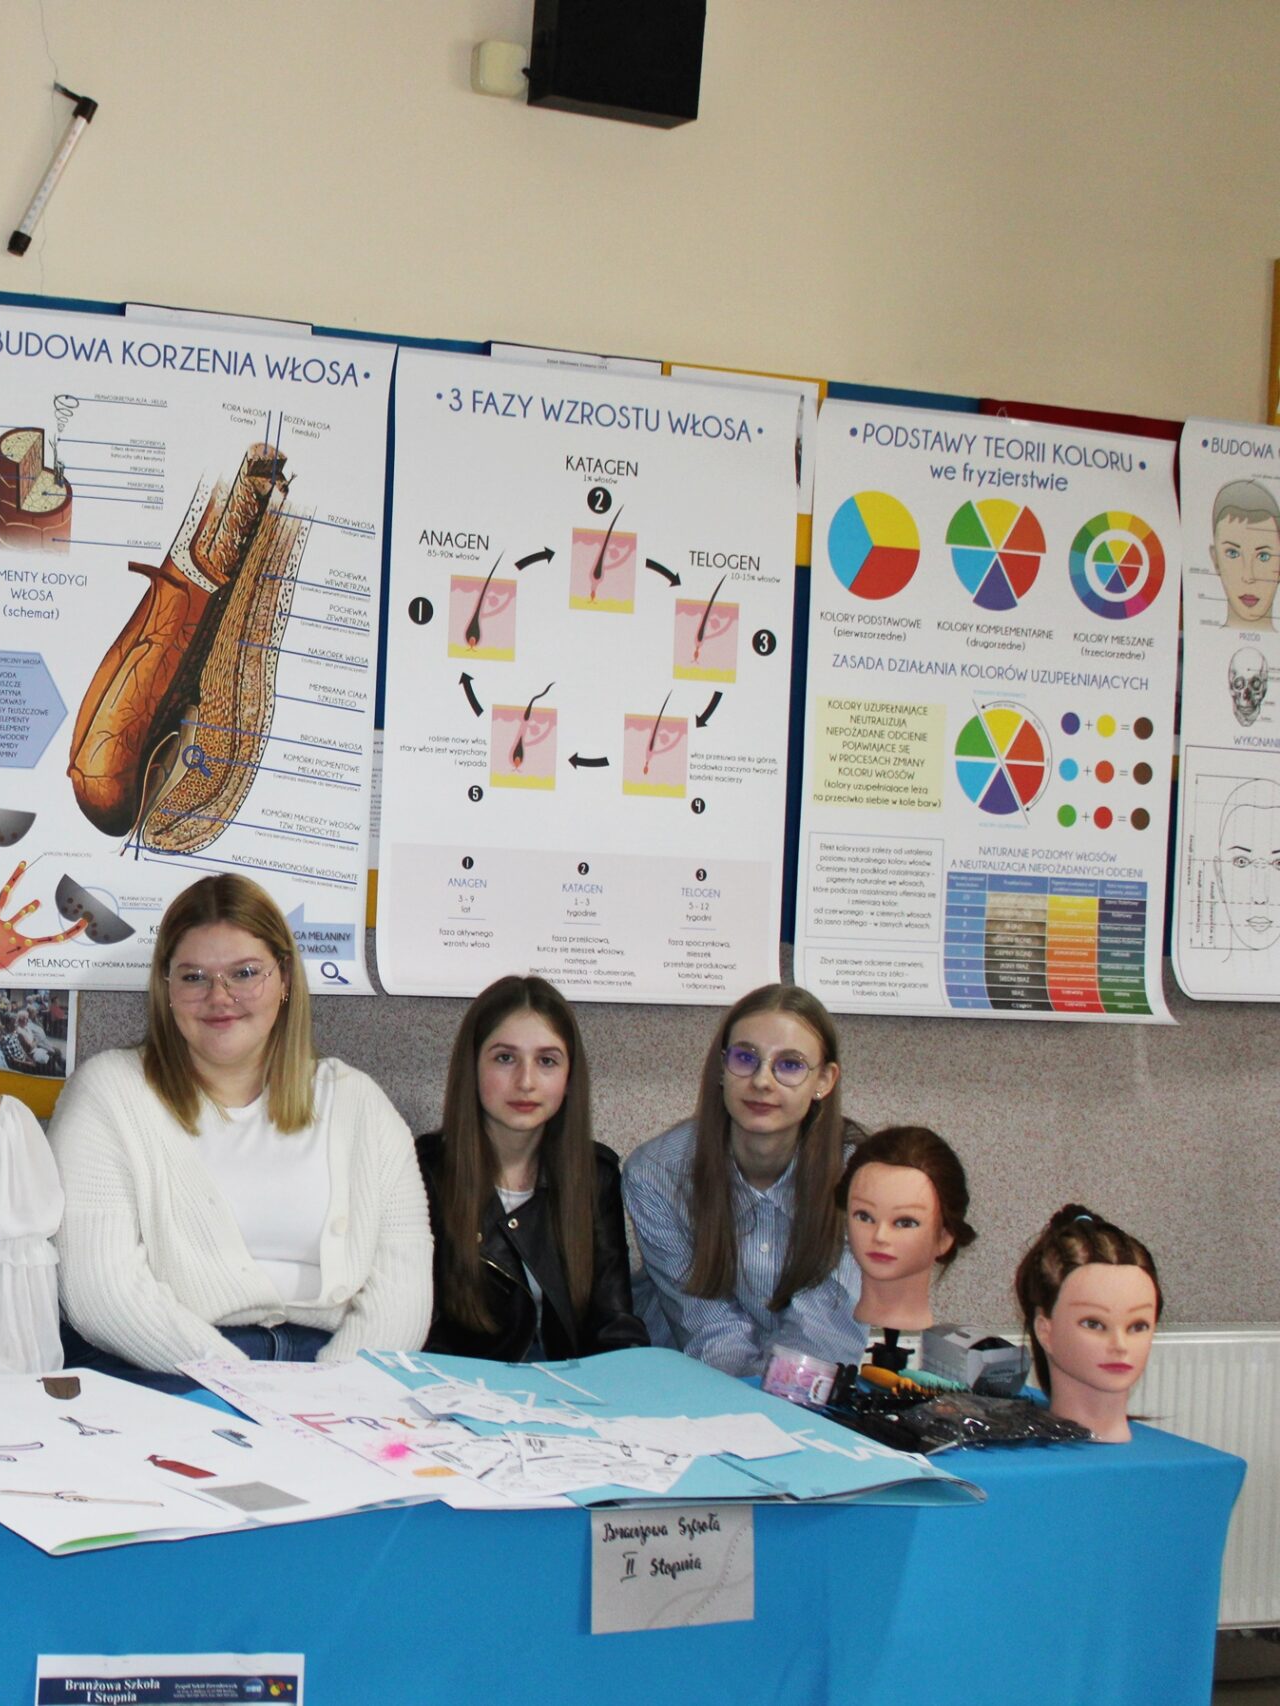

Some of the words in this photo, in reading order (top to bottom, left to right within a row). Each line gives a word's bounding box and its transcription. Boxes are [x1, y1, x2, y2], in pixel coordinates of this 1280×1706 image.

[122, 340, 257, 378] KORZENIA
[265, 354, 358, 387] WŁOSA
[448, 388, 463, 412] 3
[472, 390, 533, 419] FAZY
[541, 397, 660, 432] WZROSTU
[668, 410, 752, 443] WŁOSA
[862, 422, 977, 455] PODSTAWY
[983, 435, 1045, 463] TEORII
[1052, 444, 1133, 473] KOLORU
[1211, 437, 1274, 459] BUDOWA
[566, 455, 638, 477] KATAGEN
[930, 463, 956, 481] we
[962, 462, 1069, 492] fryzjerstwie
[595, 490, 603, 511] 2
[418, 529, 489, 551] ANAGEN
[689, 550, 760, 571] TELOGEN
[41, 573, 88, 588] ŁODYGI
[11, 588, 54, 602] WŁOSA
[2, 604, 60, 620] (schemat)
[820, 611, 856, 625] KOLORY
[857, 615, 922, 629] PODSTAWOWE
[937, 621, 973, 633] KOLORY
[975, 623, 1054, 640] KOMPLEMENTARNE
[759, 633, 769, 653] 3
[1073, 632, 1108, 645] KOLORY
[1110, 634, 1155, 648] MIESZANE
[832, 653, 885, 671] ZASADA
[888, 658, 958, 676] DZIAŁANIA
[960, 663, 1029, 682] KOLORÓW
[828, 700, 862, 711] KOLORY
[887, 730, 928, 742] ODCIENIE
[839, 754, 891, 766] PROCESACH
[892, 757, 925, 768] ZMIANY
[838, 767, 873, 778] KOLORU
[472, 787, 479, 800] 5
[695, 799, 701, 812] 4
[979, 847, 1030, 859] NATURALNE
[1031, 848, 1073, 860] POZIOMY
[447, 877, 488, 888] ANAGEN
[562, 883, 603, 894] KATAGEN
[681, 887, 721, 898] TELOGEN
[308, 931, 351, 941] MELANINY
[27, 958, 90, 969] MELANOCYT
[620, 1551, 638, 1583] II
[649, 1553, 703, 1581] Stopnia
[64, 1678, 122, 1692] Branżowa
[123, 1678, 161, 1691] Szkoła
[94, 1691, 137, 1706] Stopnia
